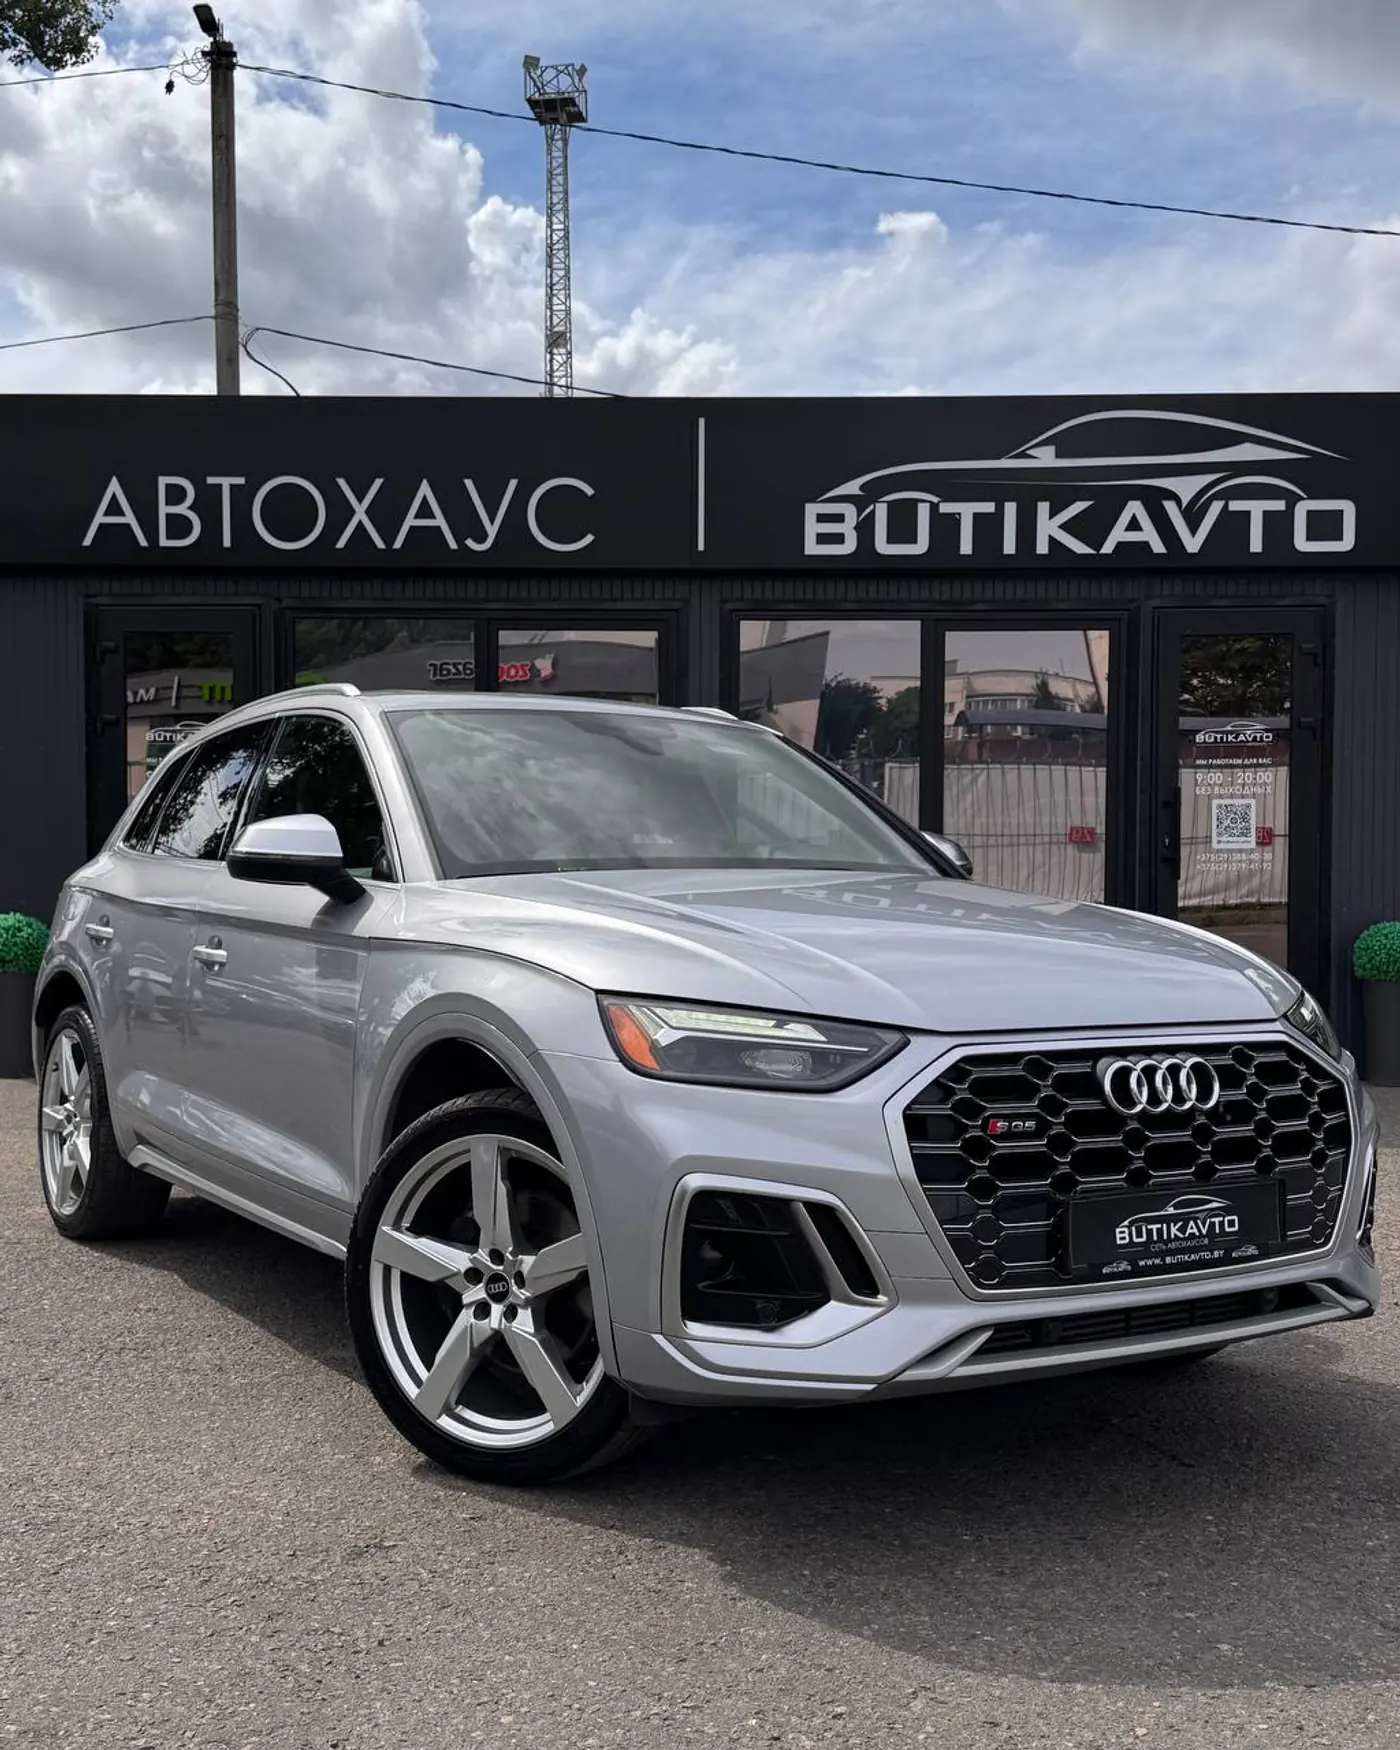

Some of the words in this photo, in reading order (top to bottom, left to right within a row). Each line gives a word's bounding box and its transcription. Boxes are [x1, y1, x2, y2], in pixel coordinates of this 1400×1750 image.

[82, 476, 595, 552] АВТОХАУС
[804, 499, 1356, 556] BUTIKAVTO
[1195, 732, 1272, 742] BUTIKAVTO
[1209, 757, 1242, 765] РАБОТАЕМ
[1243, 757, 1257, 765] ДЛЯ
[1258, 757, 1273, 765] ВАС
[1195, 772, 1223, 784] 9:00
[1236, 772, 1273, 784] 20:00
[1195, 786, 1211, 795] БЕЗ
[1213, 786, 1272, 795] ВЫХОДНЫХ
[1115, 1215, 1239, 1245] BUTIKAVTO
